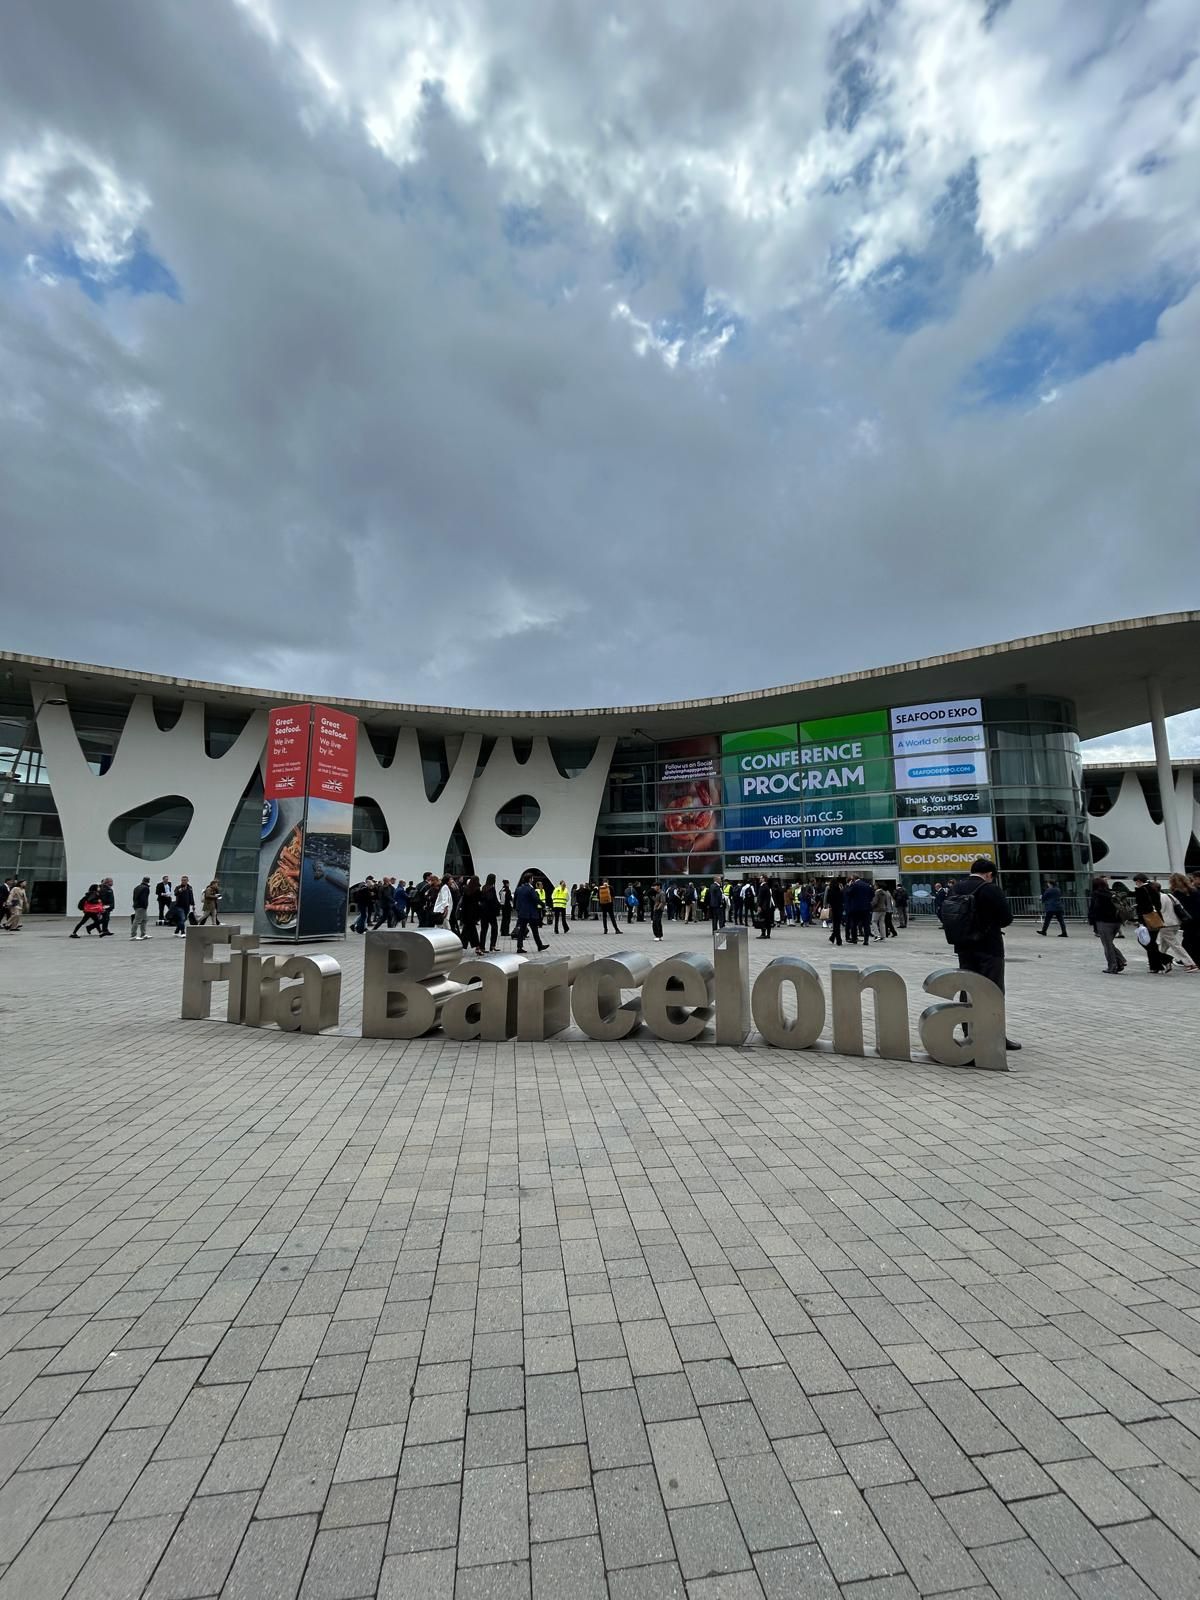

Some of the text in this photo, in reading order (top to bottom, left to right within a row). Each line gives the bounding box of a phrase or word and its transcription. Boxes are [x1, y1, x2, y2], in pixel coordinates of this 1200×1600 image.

[896, 707, 978, 724] SEAFOOD EXPO
[276, 718, 294, 726] Great
[321, 718, 340, 729] Great
[275, 725, 301, 735] Seafood.
[320, 726, 348, 740] Seafood.
[320, 737, 342, 750] We live
[906, 738, 931, 748] World
[942, 734, 980, 744] Seafood
[320, 746, 327, 756] by
[741, 742, 862, 771] CONFERENCE
[912, 767, 971, 776] SEAFOODEXPO.COM
[744, 766, 864, 796] PROGRAM
[905, 793, 980, 805] Thank You #SEG25
[922, 804, 963, 813] Sponsors!
[763, 811, 843, 826] Visit Room CC.5
[769, 827, 843, 840] to learn more
[912, 823, 978, 839] Cooke
[740, 854, 784, 864] ENTRANCE
[815, 851, 884, 861] SOUTH ACCESS
[904, 854, 936, 864] GOLD
[182, 925, 1008, 1071] Fira Barcelona
